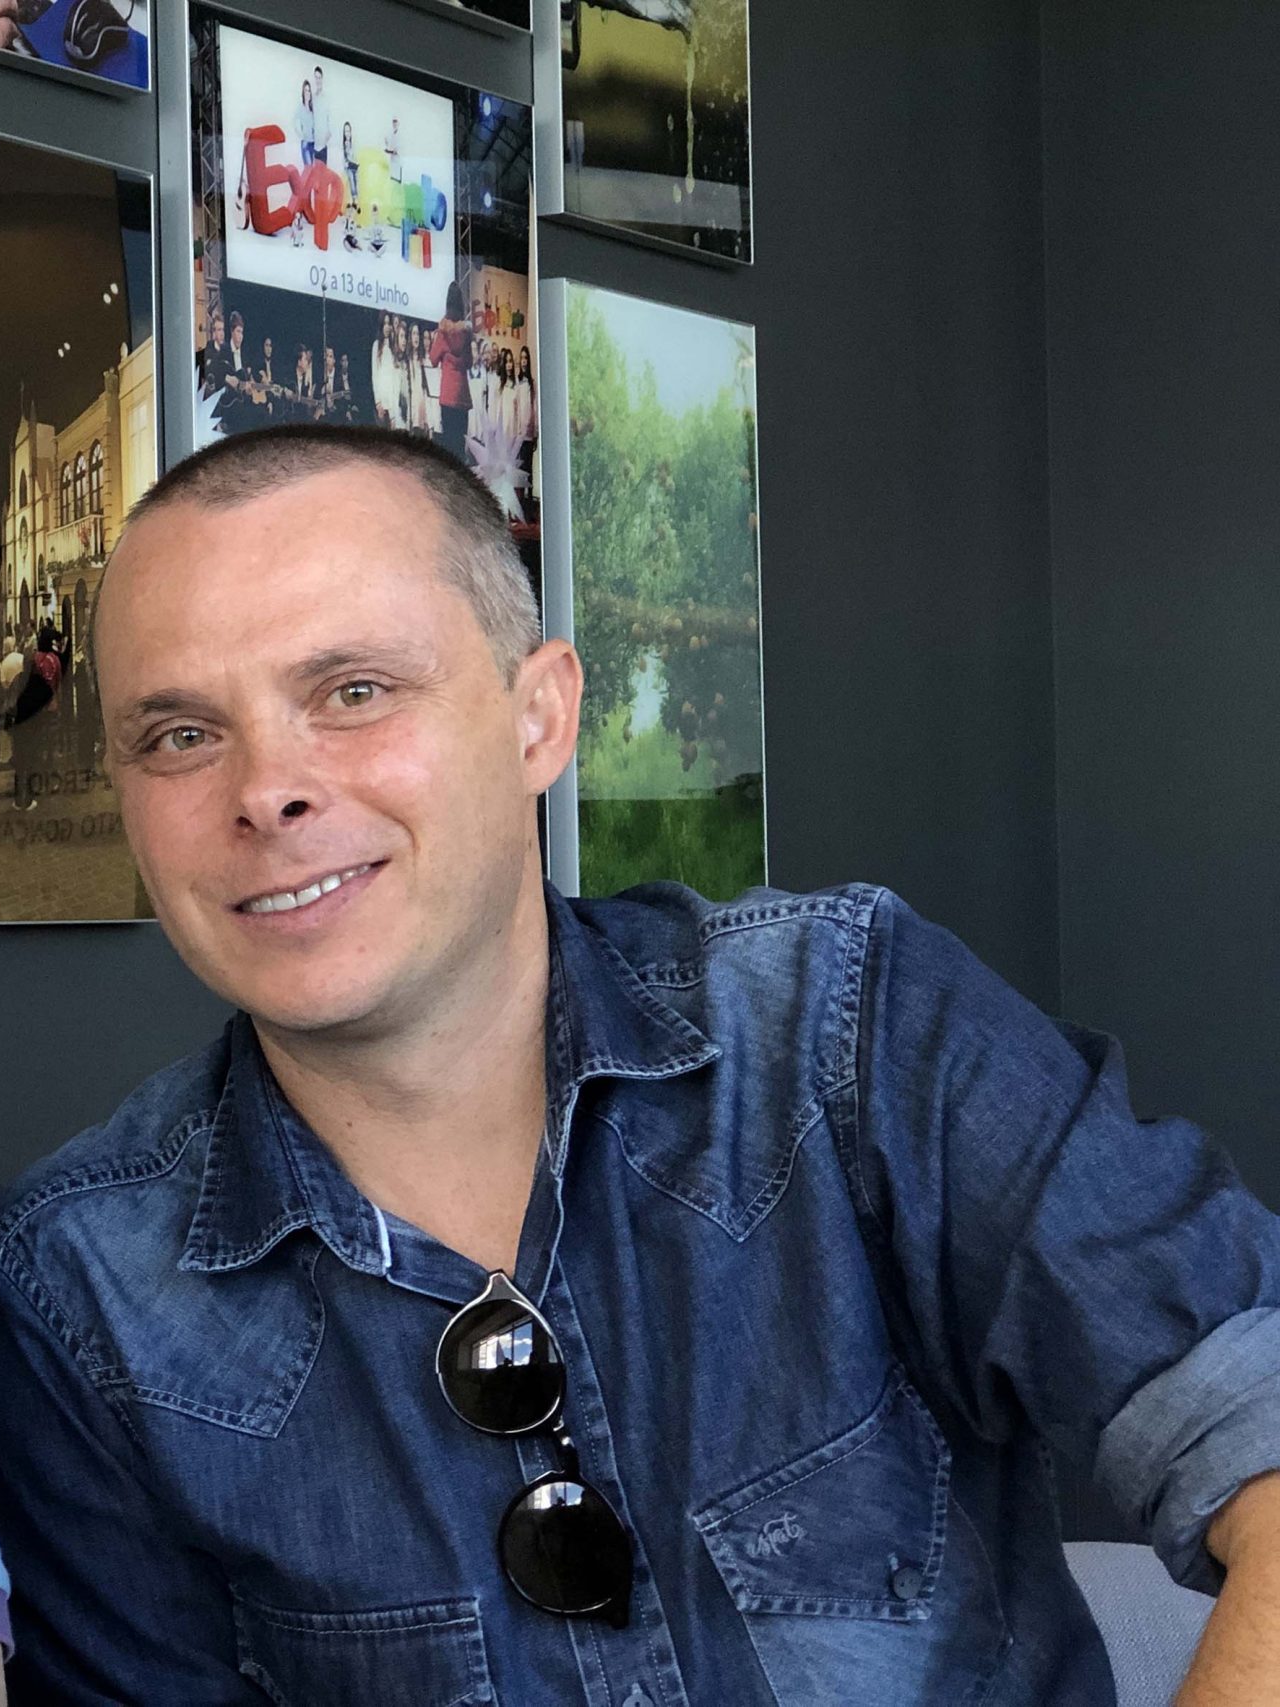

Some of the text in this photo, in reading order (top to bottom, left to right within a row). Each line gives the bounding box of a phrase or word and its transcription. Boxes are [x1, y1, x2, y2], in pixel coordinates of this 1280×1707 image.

[309, 265, 410, 306] 02 a 13 de Junho
